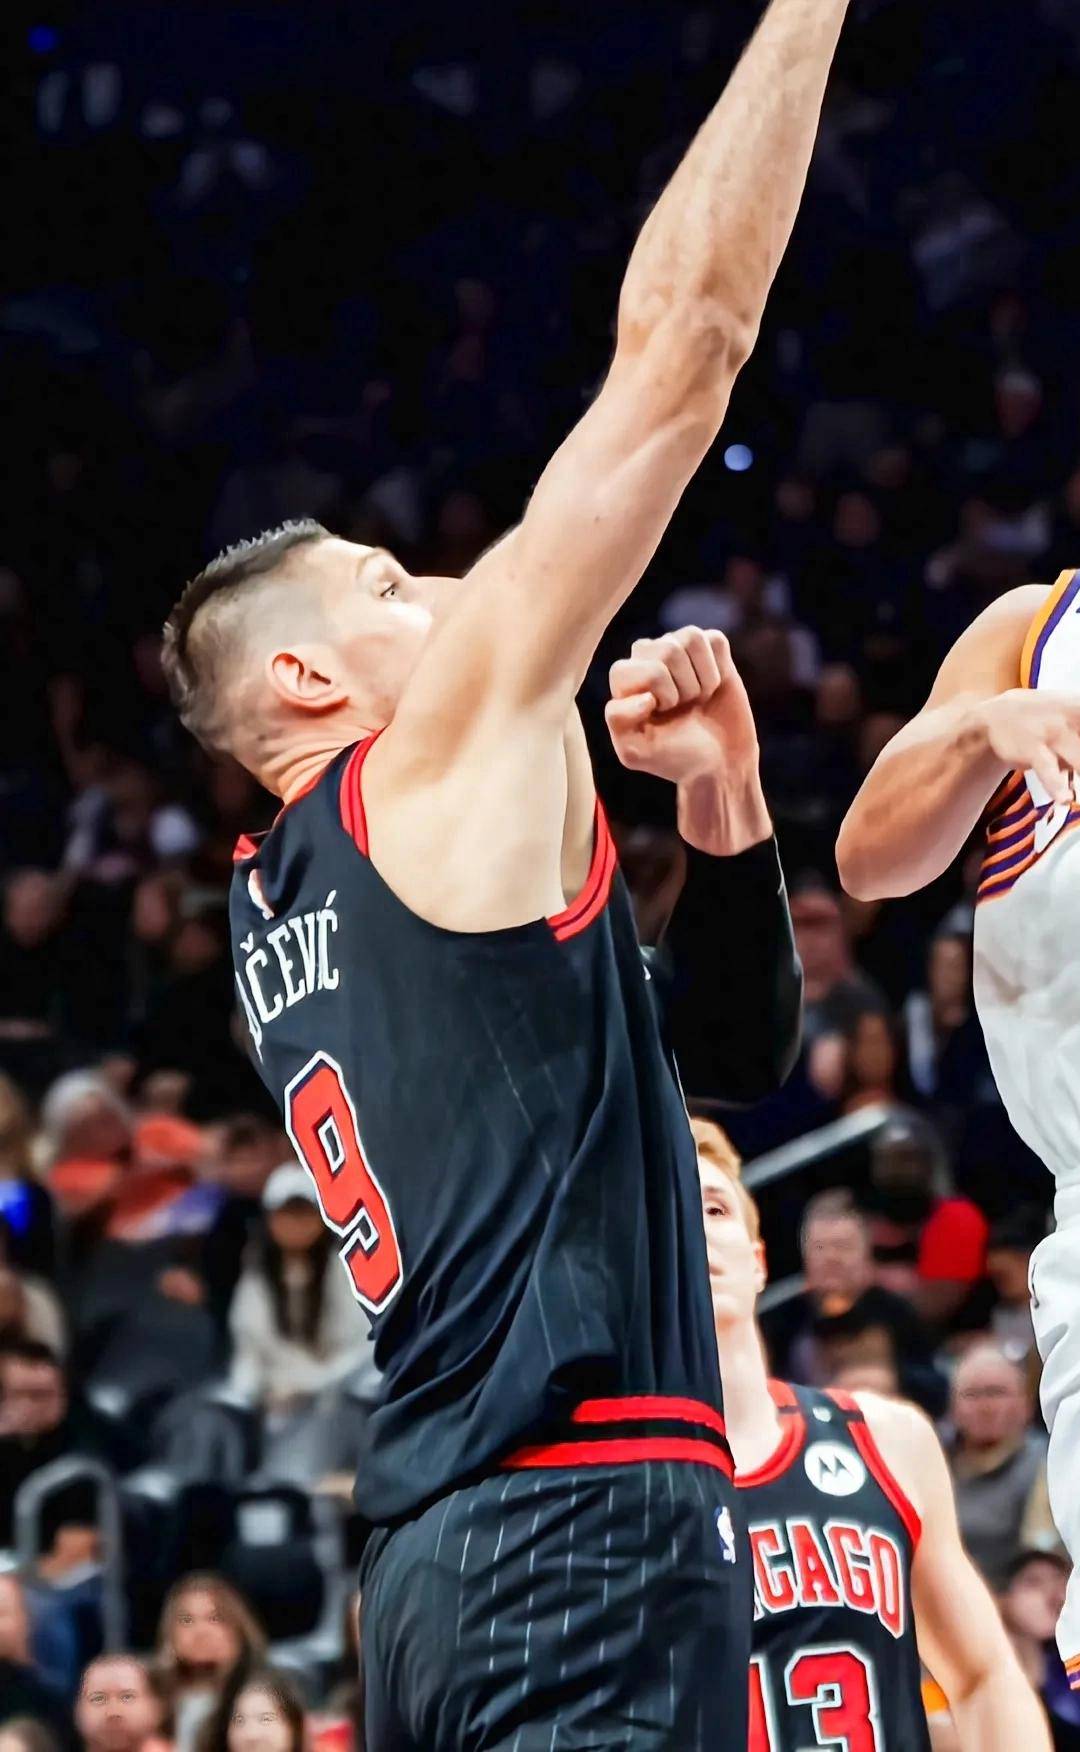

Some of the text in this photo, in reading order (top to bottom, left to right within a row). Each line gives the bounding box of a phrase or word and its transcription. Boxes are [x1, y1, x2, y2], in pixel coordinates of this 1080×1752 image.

[235, 889, 339, 1066] ČEVIĆ
[284, 1050, 404, 1315] 9
[748, 1518, 904, 1639] CAGO
